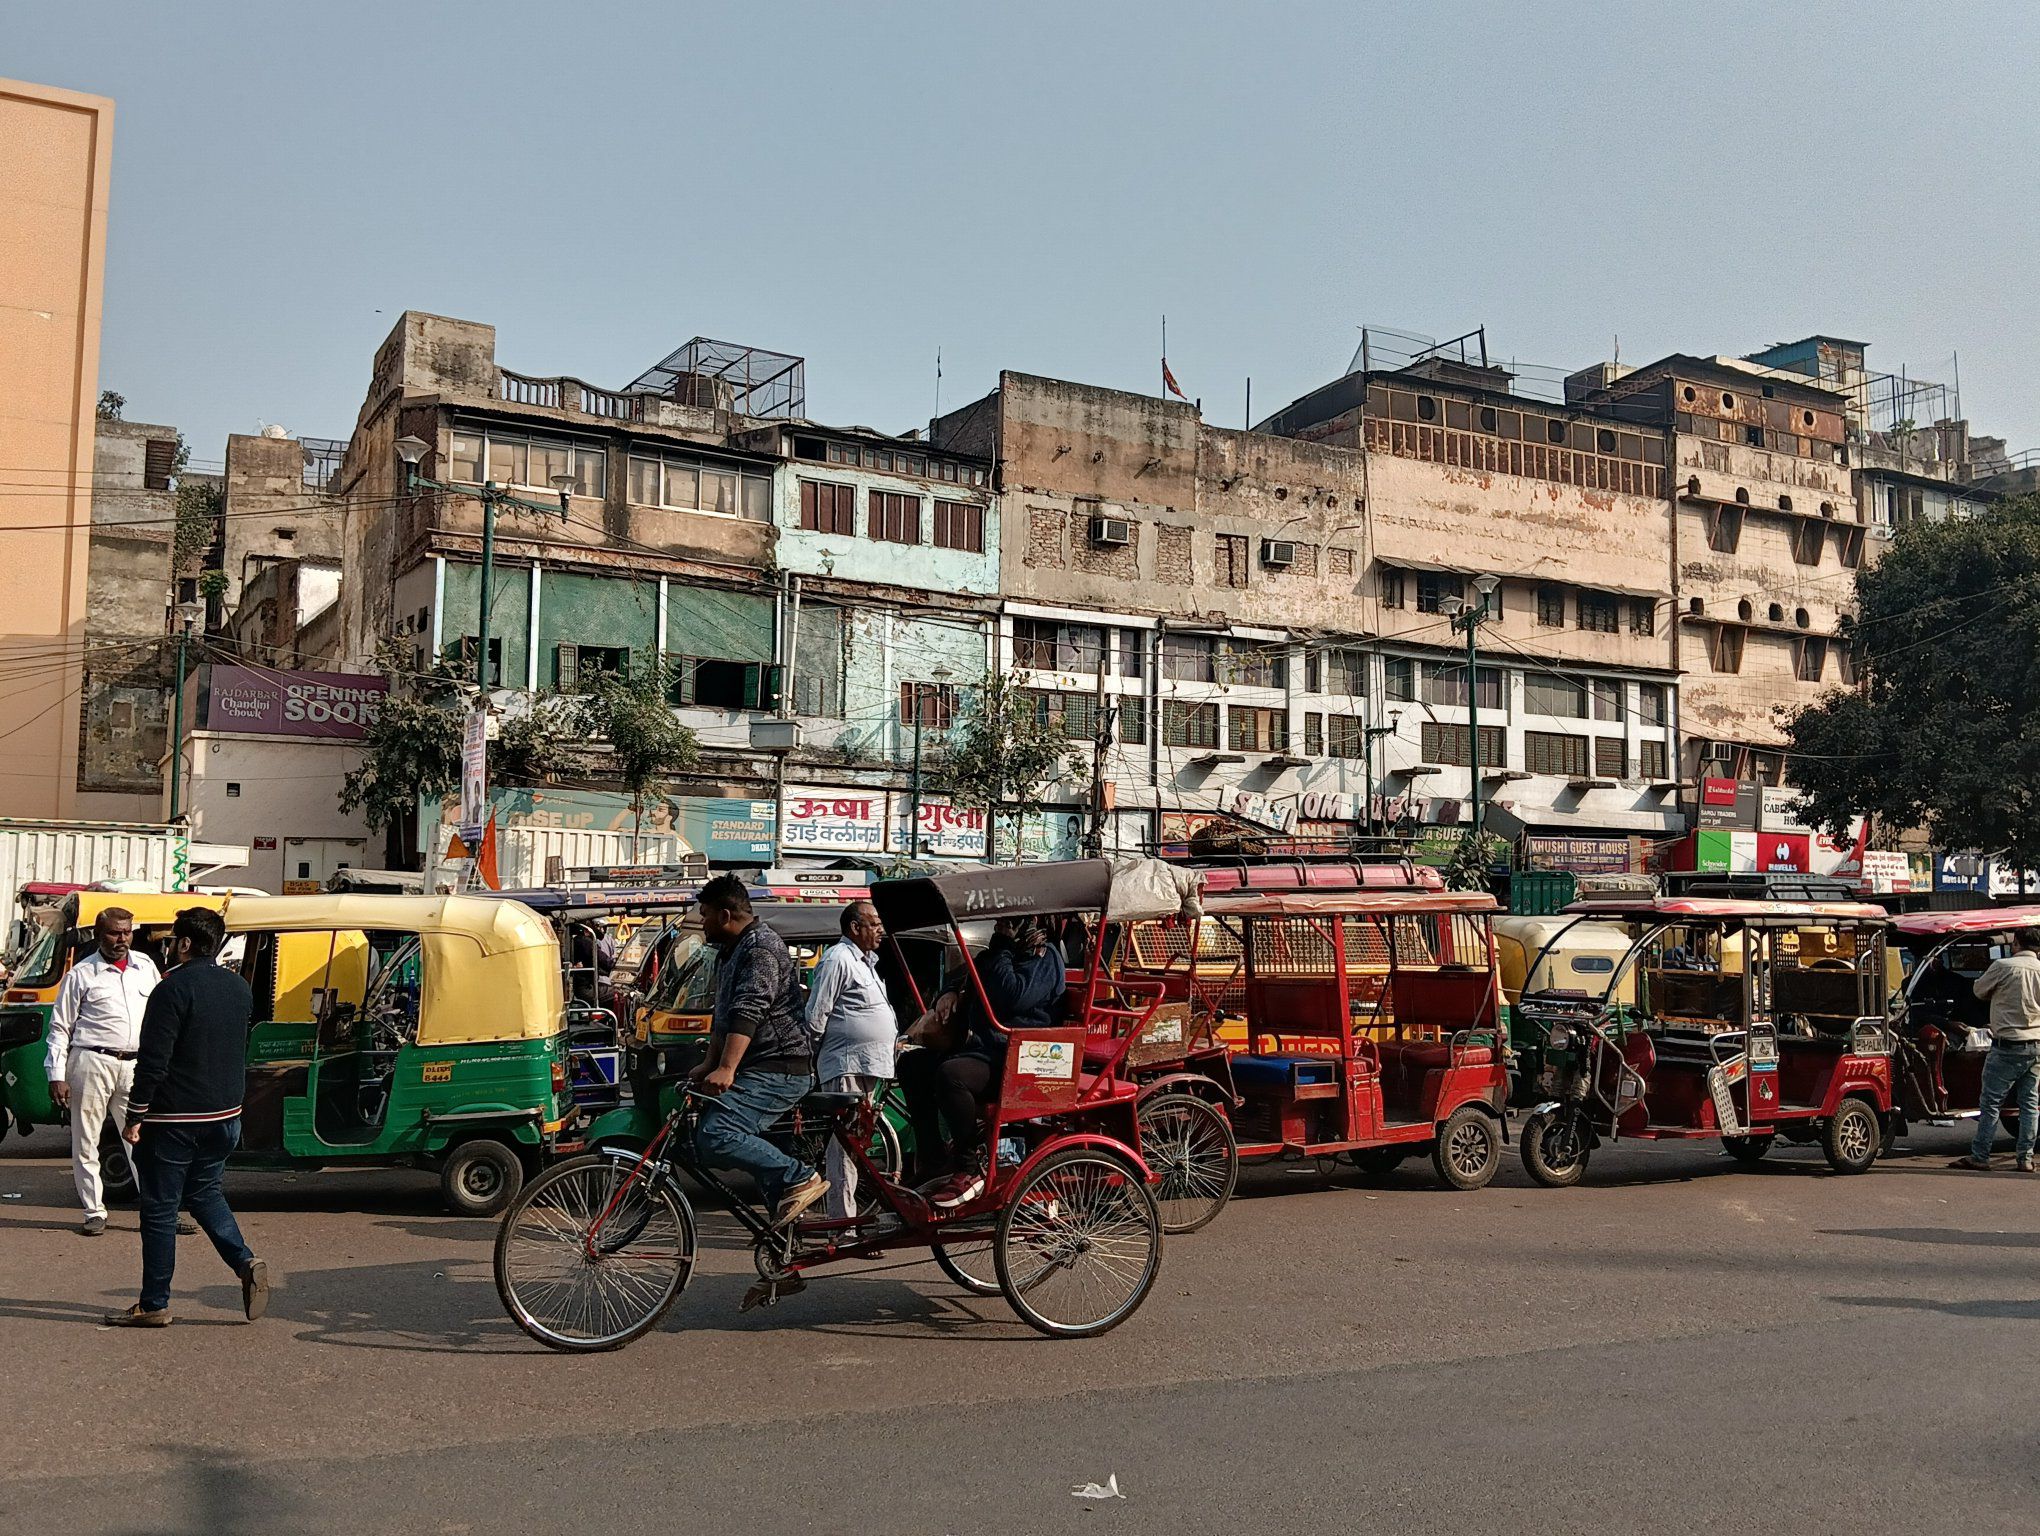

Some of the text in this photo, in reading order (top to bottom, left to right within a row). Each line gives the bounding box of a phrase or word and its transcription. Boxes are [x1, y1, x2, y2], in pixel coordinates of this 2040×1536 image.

[214, 687, 279, 700] RAJDARBAR
[287, 684, 381, 703] OPENING
[221, 697, 270, 711] Chandini
[229, 708, 263, 720] chowk
[284, 698, 381, 725] SOON
[1303, 791, 1343, 820] OM
[711, 820, 765, 831] STANDARD
[711, 830, 776, 842] RESTAURANT
[1531, 840, 1568, 854] KHUSHI
[1569, 841, 1598, 855] GUEST
[1599, 842, 1628, 855] HOUSE
